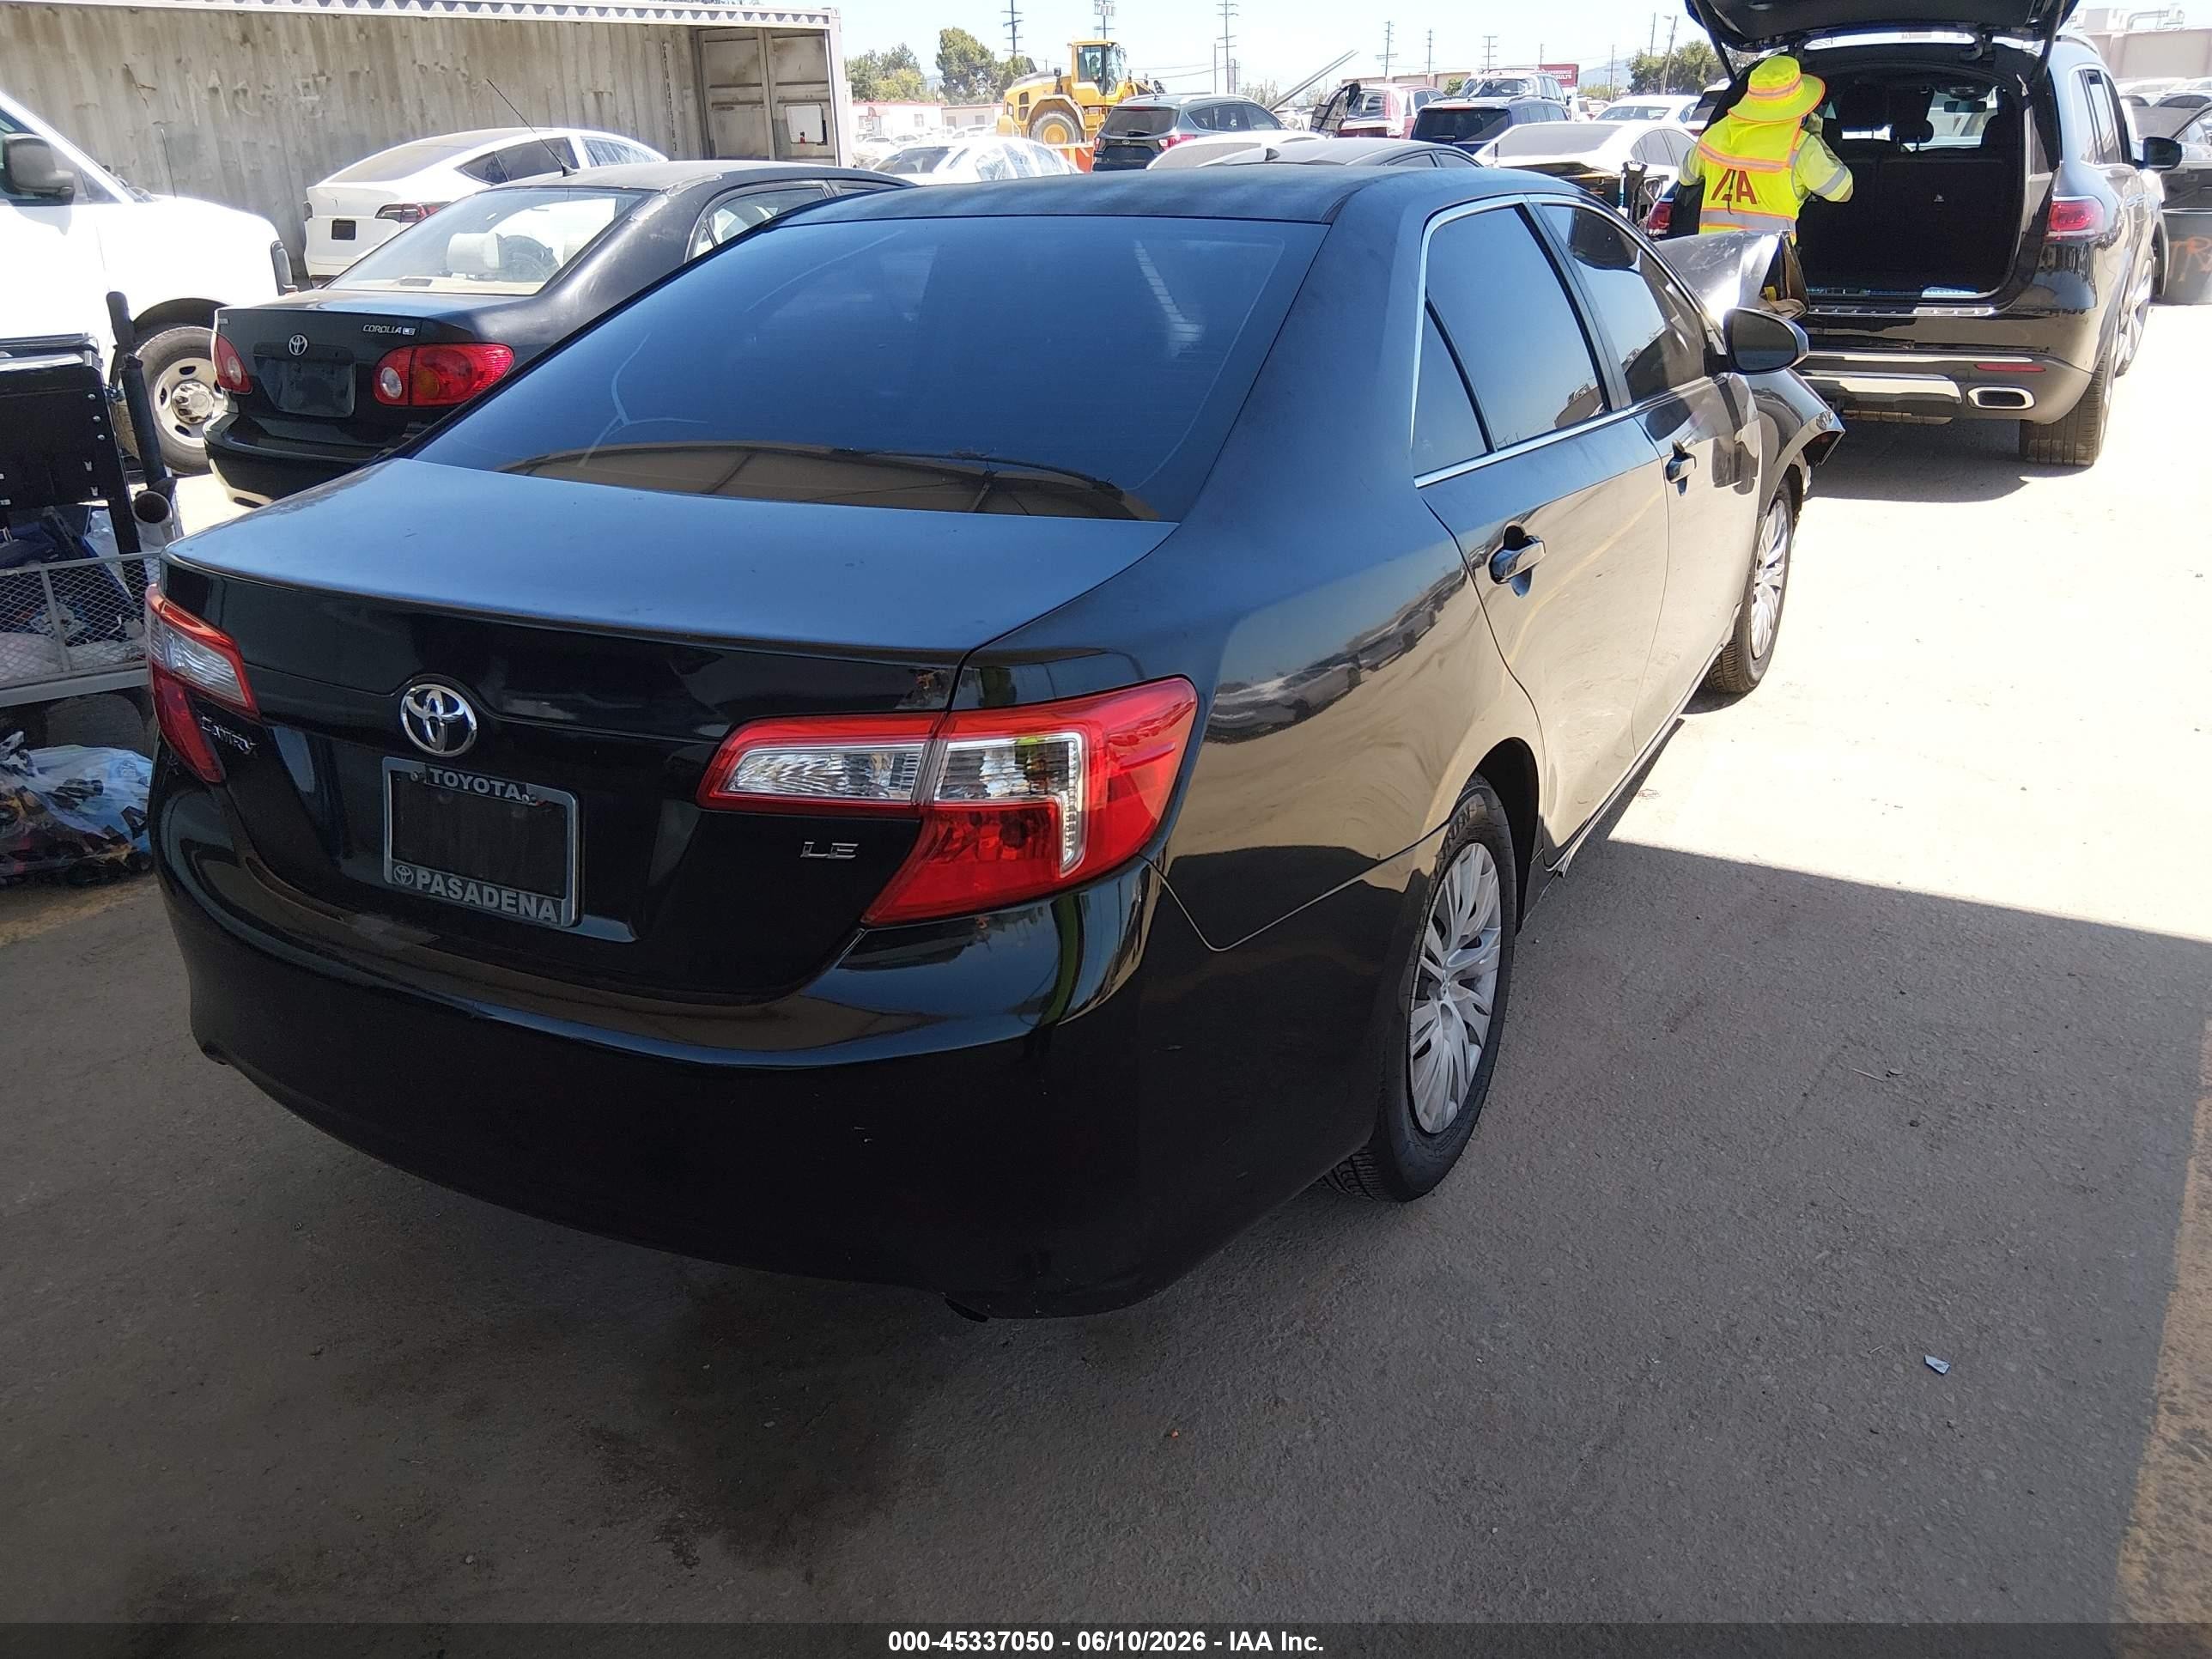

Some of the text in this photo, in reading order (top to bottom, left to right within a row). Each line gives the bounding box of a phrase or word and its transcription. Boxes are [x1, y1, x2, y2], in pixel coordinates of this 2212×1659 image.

[362, 324, 402, 334] COROLLA
[429, 768, 523, 801] TOYOTA
[799, 841, 860, 860] LE
[416, 869, 558, 924] PASADENA
